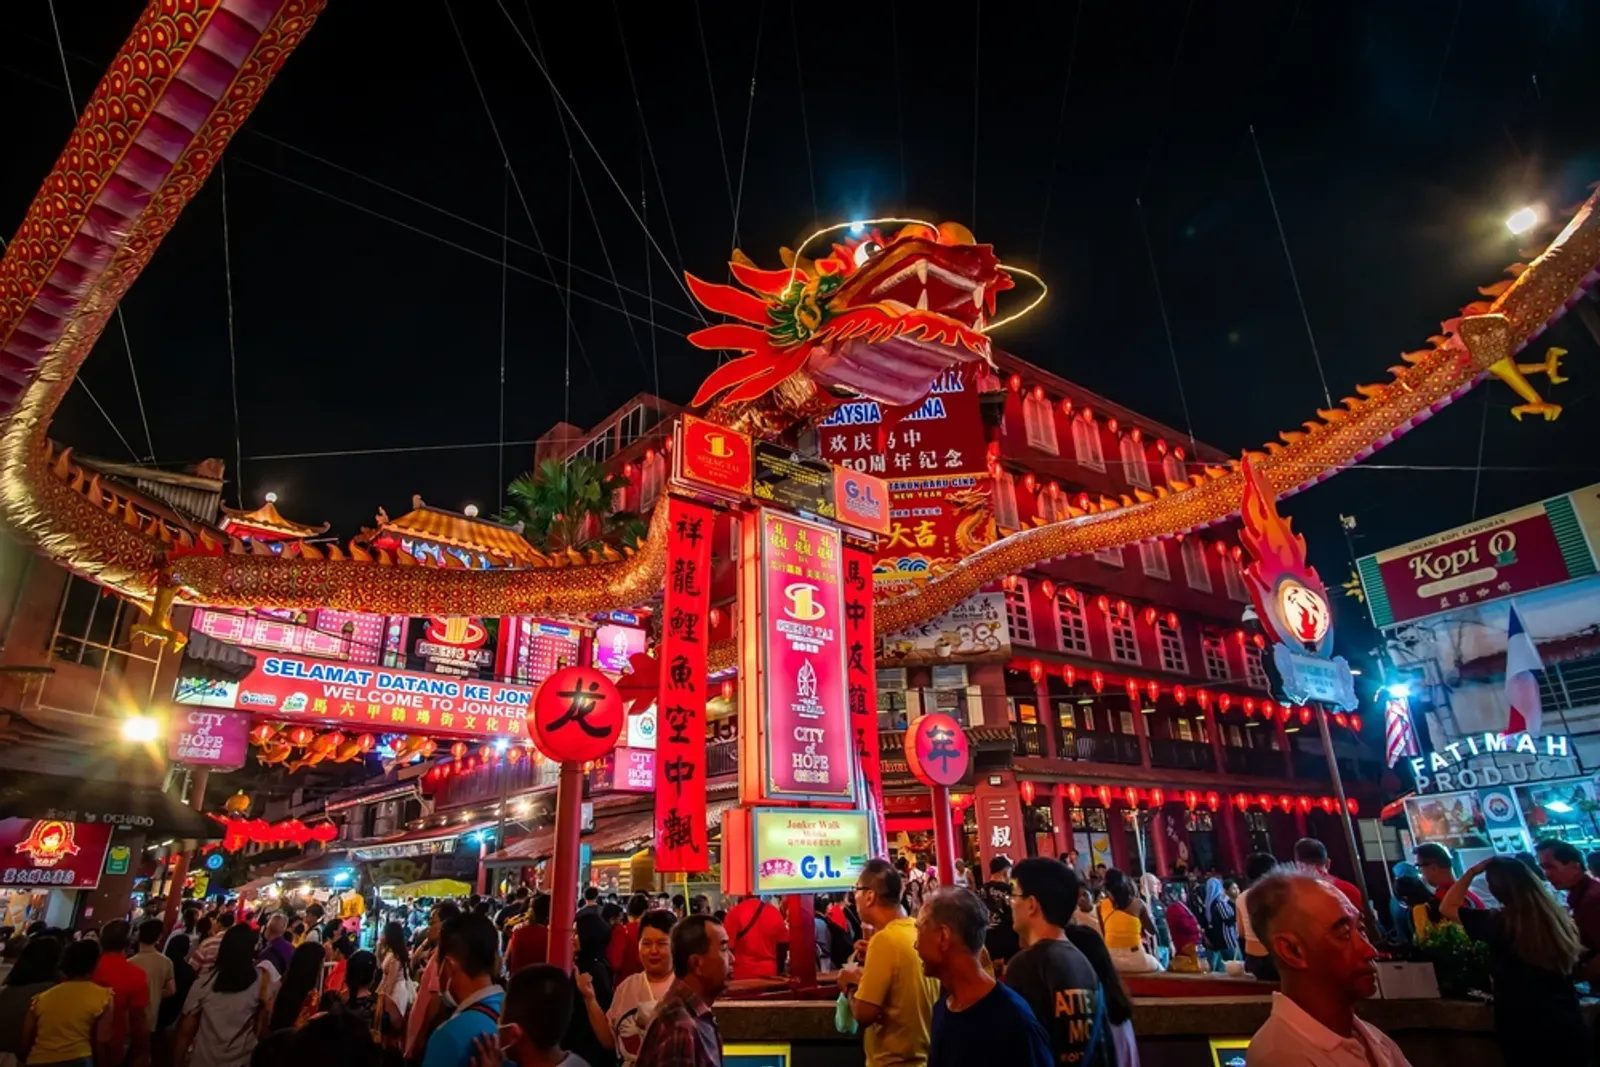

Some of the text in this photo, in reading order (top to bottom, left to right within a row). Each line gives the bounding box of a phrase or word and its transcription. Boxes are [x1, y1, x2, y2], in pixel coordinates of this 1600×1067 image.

[823, 402, 881, 425] LAYSIA
[824, 449, 963, 473] 50周年纪念
[844, 479, 879, 506] G.L.
[894, 490, 942, 500] NEW YEAR
[879, 520, 937, 550] 大吉
[1408, 539, 1480, 580] Kopi
[264, 658, 373, 686] SELAMAT
[378, 673, 458, 697] DATANG
[465, 684, 490, 700] KE
[323, 685, 424, 708] WELCOME
[430, 697, 453, 711] TO
[458, 701, 527, 720] JONKER
[545, 677, 612, 738] 龙
[188, 712, 226, 726] CITY
[180, 733, 223, 748] HOPE
[794, 726, 825, 743] CITY
[630, 752, 652, 763] CITY
[792, 753, 829, 769] HOPE
[926, 725, 960, 774] 年
[1411, 732, 1568, 777] FATIMAH
[1415, 756, 1578, 795] PRODUCT
[103, 813, 154, 826] OCHADO
[786, 820, 840, 829] Jonker Walk
[800, 855, 841, 880] G.L.
